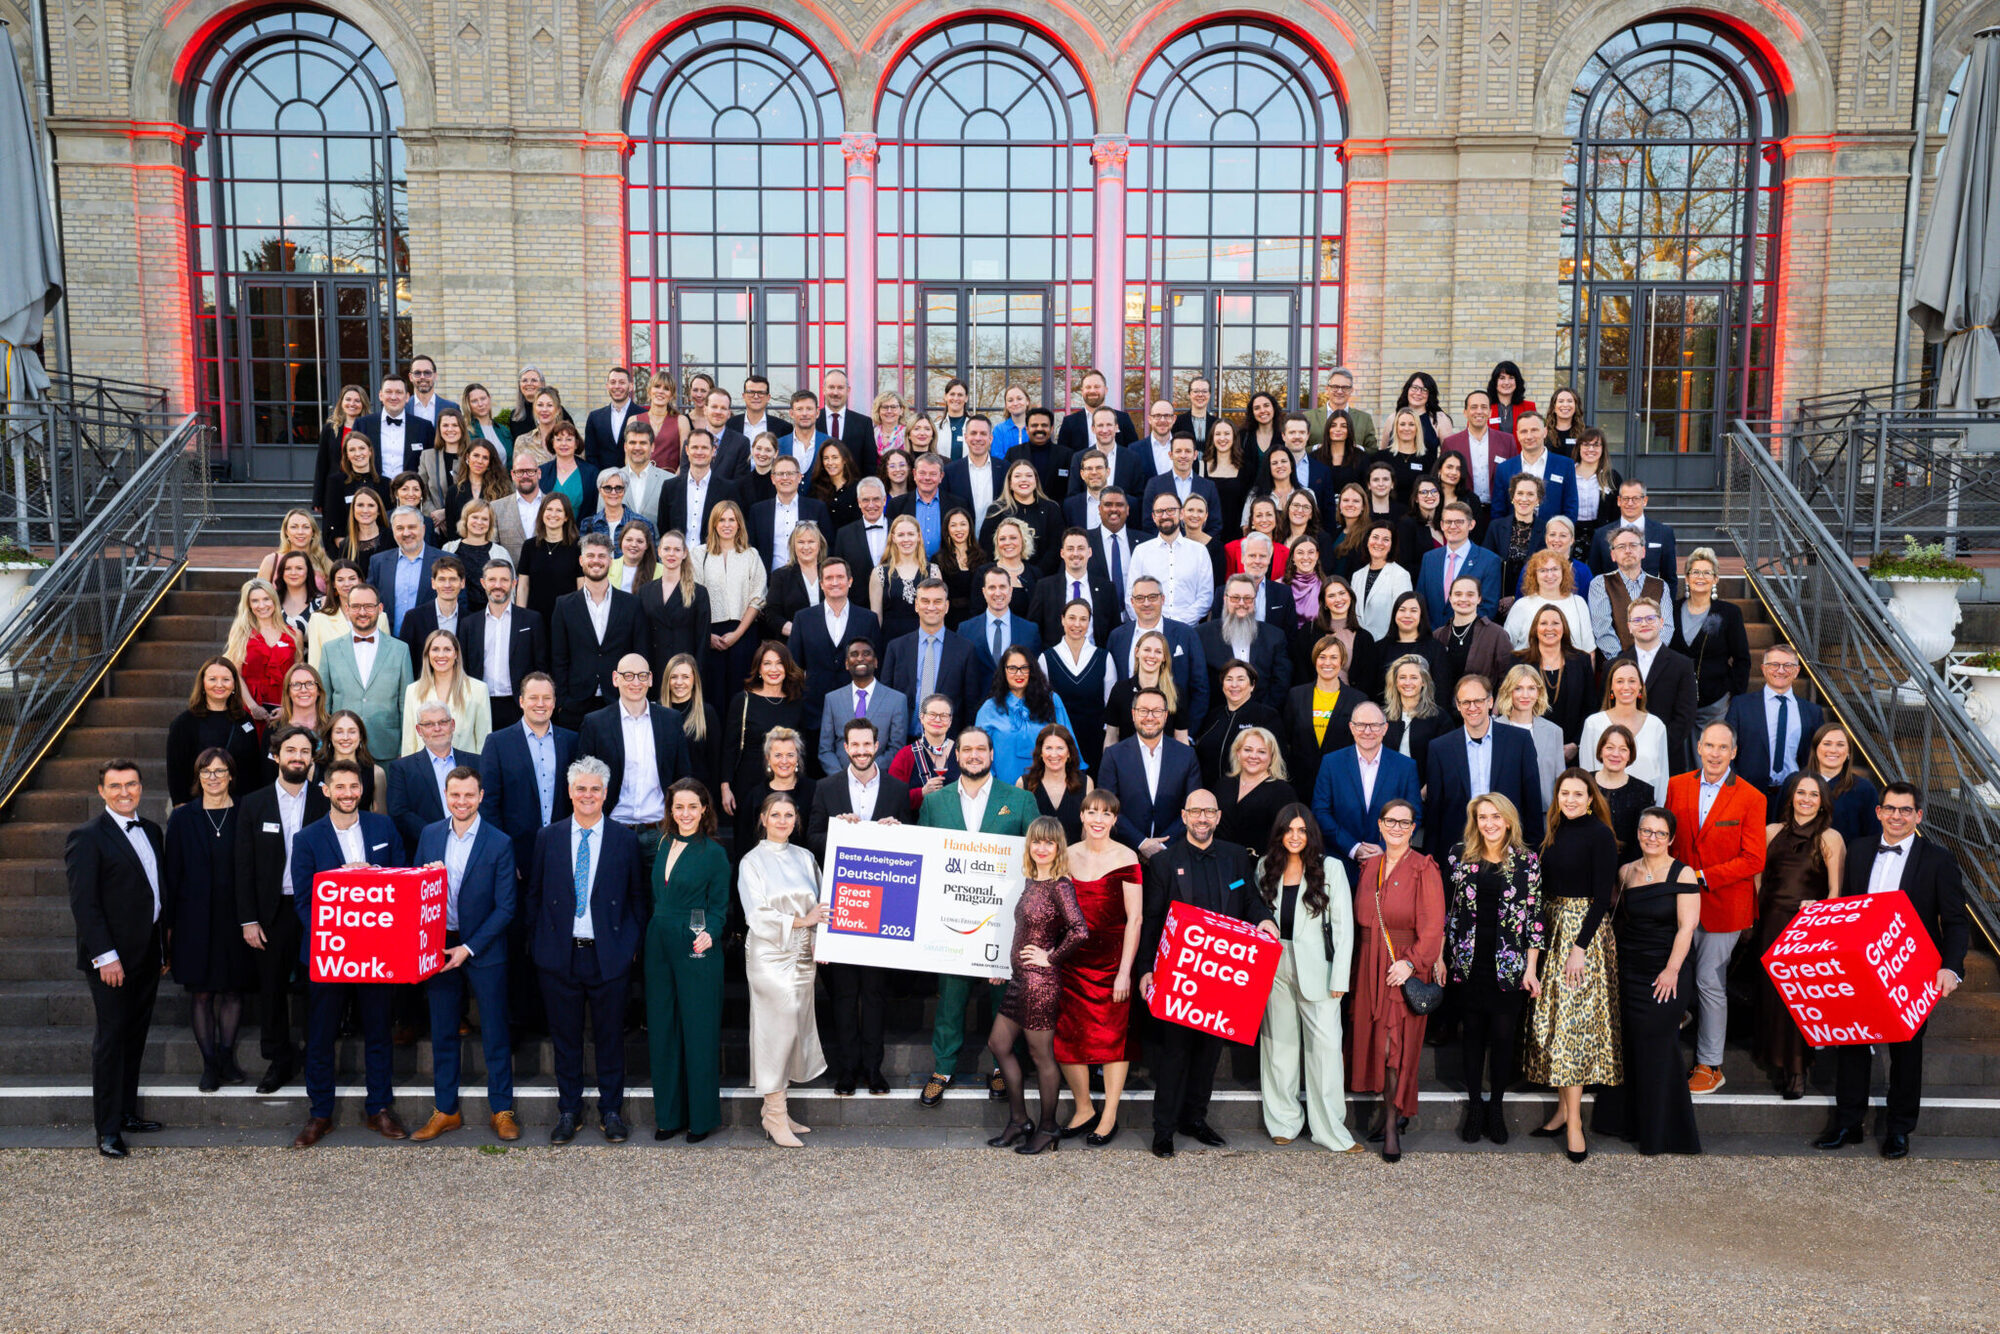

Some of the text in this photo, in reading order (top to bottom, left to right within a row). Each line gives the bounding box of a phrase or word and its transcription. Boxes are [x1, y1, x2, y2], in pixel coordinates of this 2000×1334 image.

[944, 838, 1012, 856] Handelsblatt
[839, 852, 914, 867] Beste Arbeitgeber
[970, 860, 994, 872] ddn
[837, 867, 917, 884] Deutschland
[317, 881, 395, 903] Great
[421, 876, 442, 901] Great
[839, 886, 871, 898] Great
[944, 884, 996, 897] personal.
[838, 896, 870, 908] Place
[954, 893, 1003, 906] magazin
[1803, 896, 1873, 914] Great
[318, 906, 394, 928] Place
[420, 903, 441, 926] Place
[837, 907, 849, 916] To
[1792, 912, 1861, 929] Place
[419, 930, 427, 950] To
[881, 925, 911, 937] 2026
[1783, 929, 1808, 942] To
[1866, 912, 1907, 966] Great
[315, 931, 345, 951] To
[1184, 925, 1258, 964] Great
[1177, 947, 1249, 986] Place
[1769, 958, 1845, 980] Great
[1877, 937, 1917, 989] Place
[1172, 971, 1198, 996] To
[1779, 982, 1855, 1000] Place
[1888, 984, 1909, 1008] To
[1900, 980, 1939, 1030] Work
[1790, 1004, 1822, 1022] To
